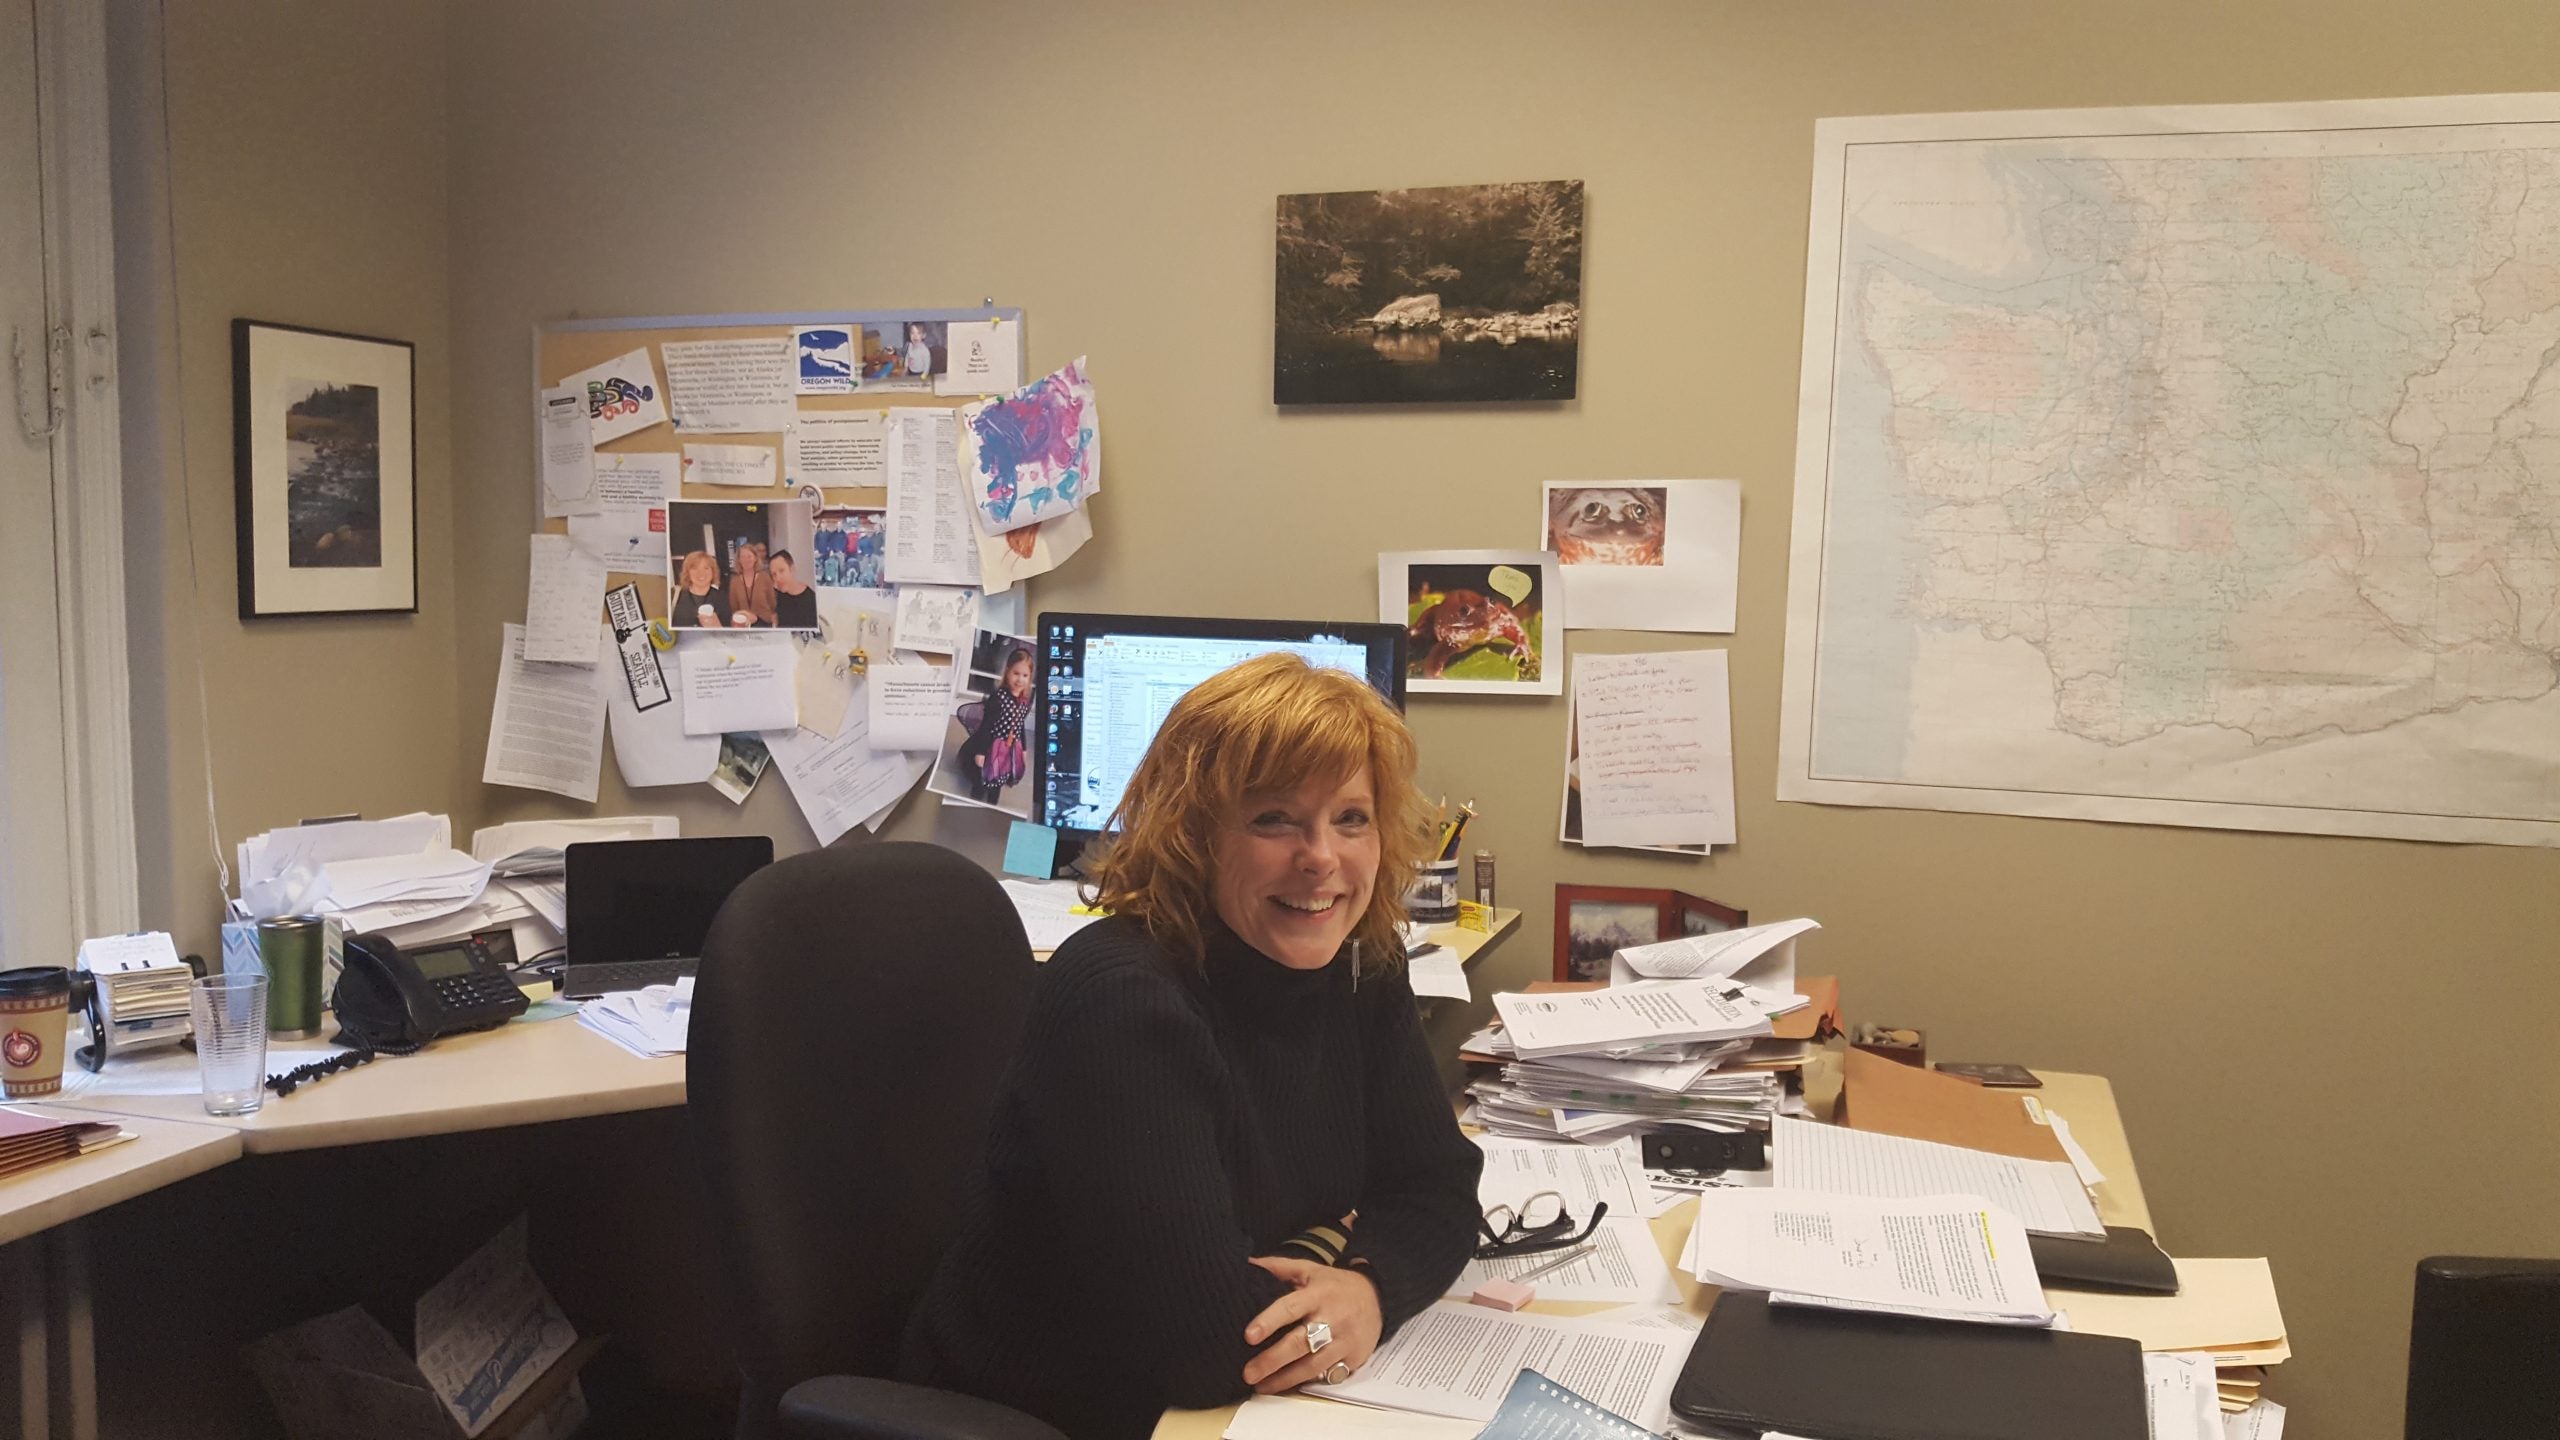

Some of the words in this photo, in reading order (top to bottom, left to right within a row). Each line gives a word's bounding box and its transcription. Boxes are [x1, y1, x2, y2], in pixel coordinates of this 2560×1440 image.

[833, 377, 851, 385] WILD
[609, 592, 629, 629] GUITARS
[631, 652, 649, 689] SEATTLE
